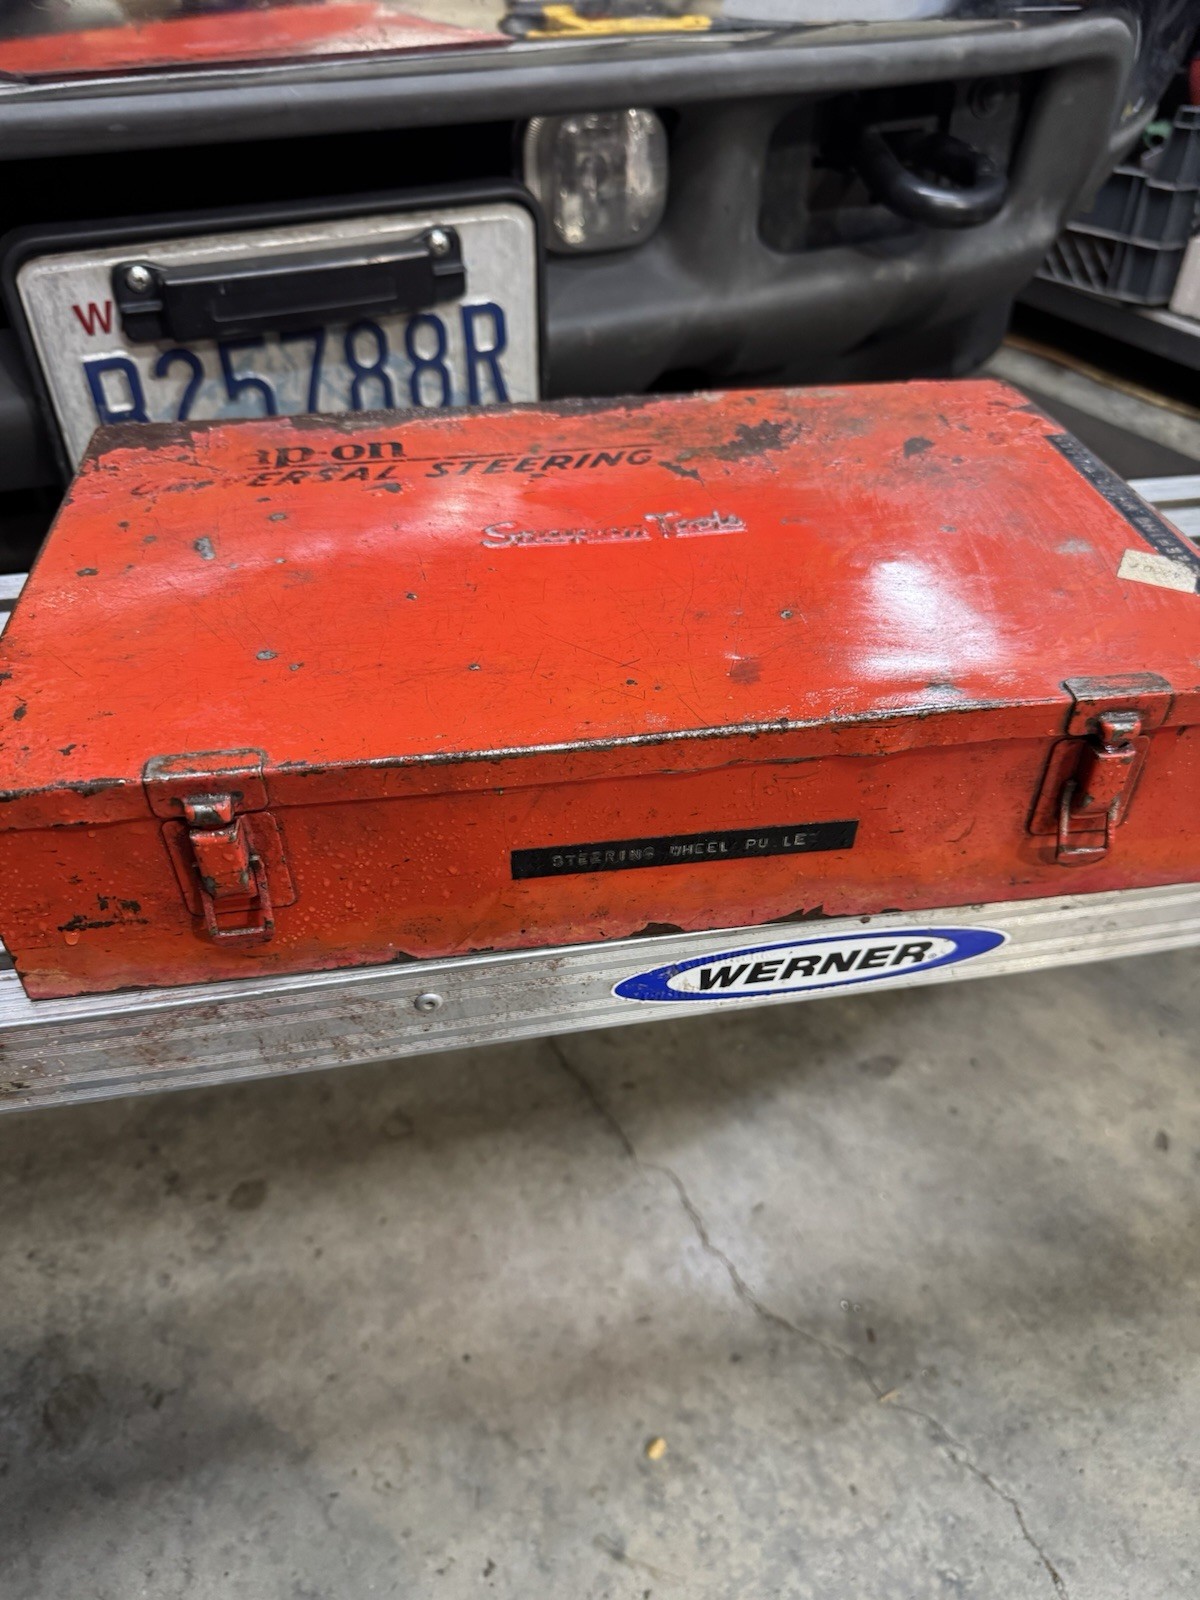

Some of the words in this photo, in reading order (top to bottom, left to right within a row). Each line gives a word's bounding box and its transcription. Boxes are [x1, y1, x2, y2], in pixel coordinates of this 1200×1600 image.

[425, 450, 653, 478] STEERING
[552, 846, 655, 868] STEERING
[670, 841, 728, 857] WHEEL
[745, 831, 820, 850] PULE
[699, 941, 935, 991] WERNER
